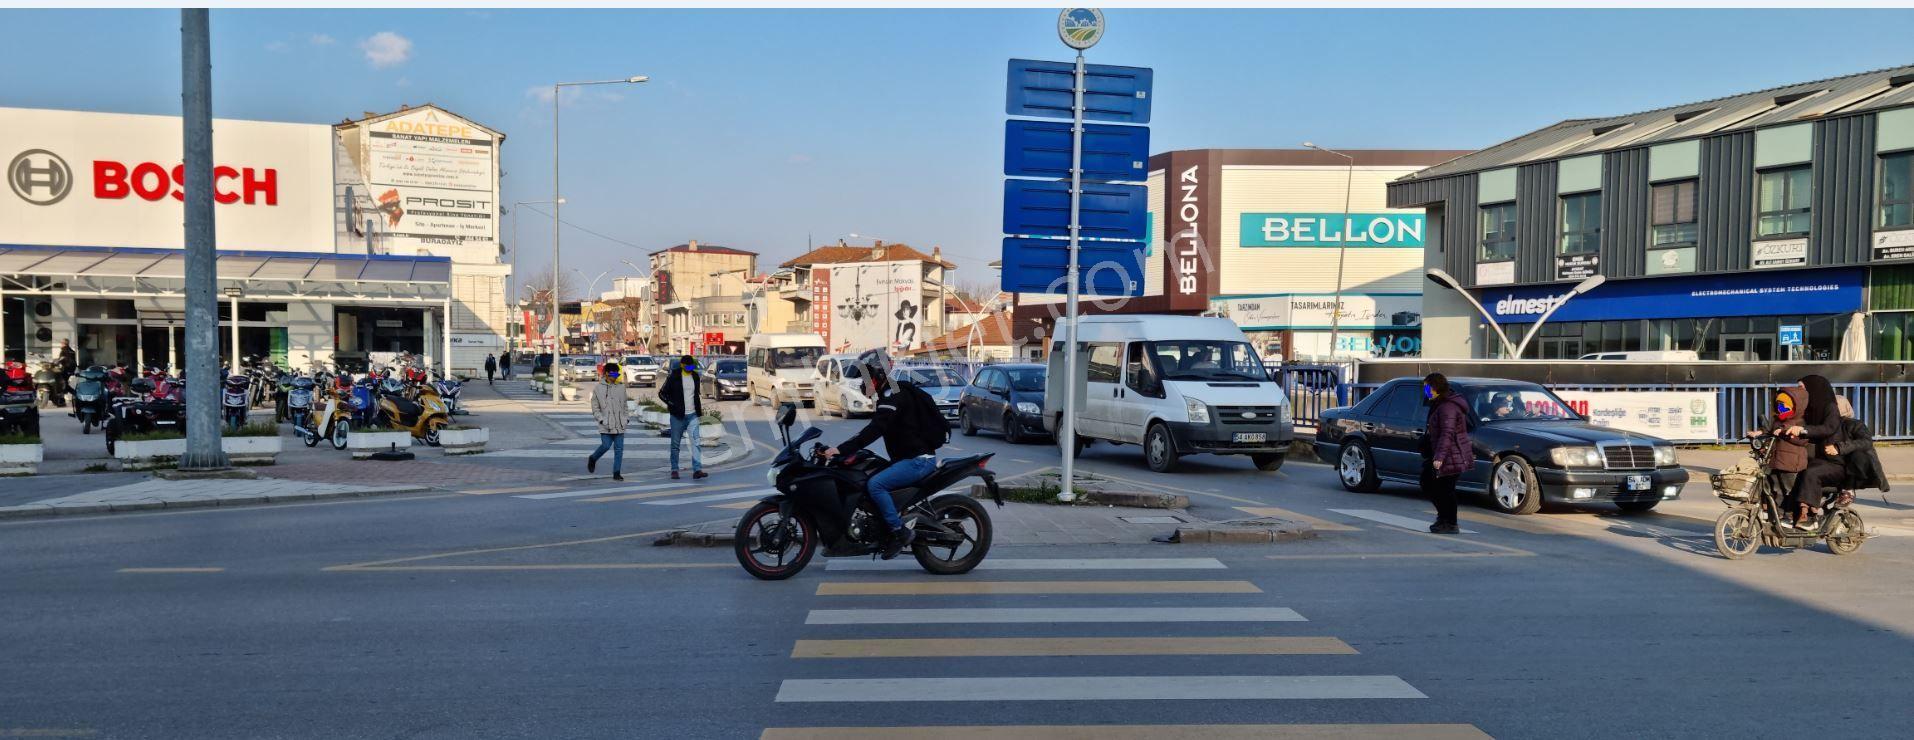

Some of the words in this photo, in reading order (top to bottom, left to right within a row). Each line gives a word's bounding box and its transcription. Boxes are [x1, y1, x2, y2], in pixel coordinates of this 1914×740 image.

[384, 120, 472, 138] ADATEPE
[406, 196, 491, 209] PROSIT
[1179, 165, 1199, 295] BELLONA
[421, 238, 463, 246] BURADAYIZ
[1691, 287, 1758, 297] ELECTROMECHANICAL
[1759, 286, 1785, 294] SYSTEM
[1787, 284, 1839, 292] TECHNOLOGIES
